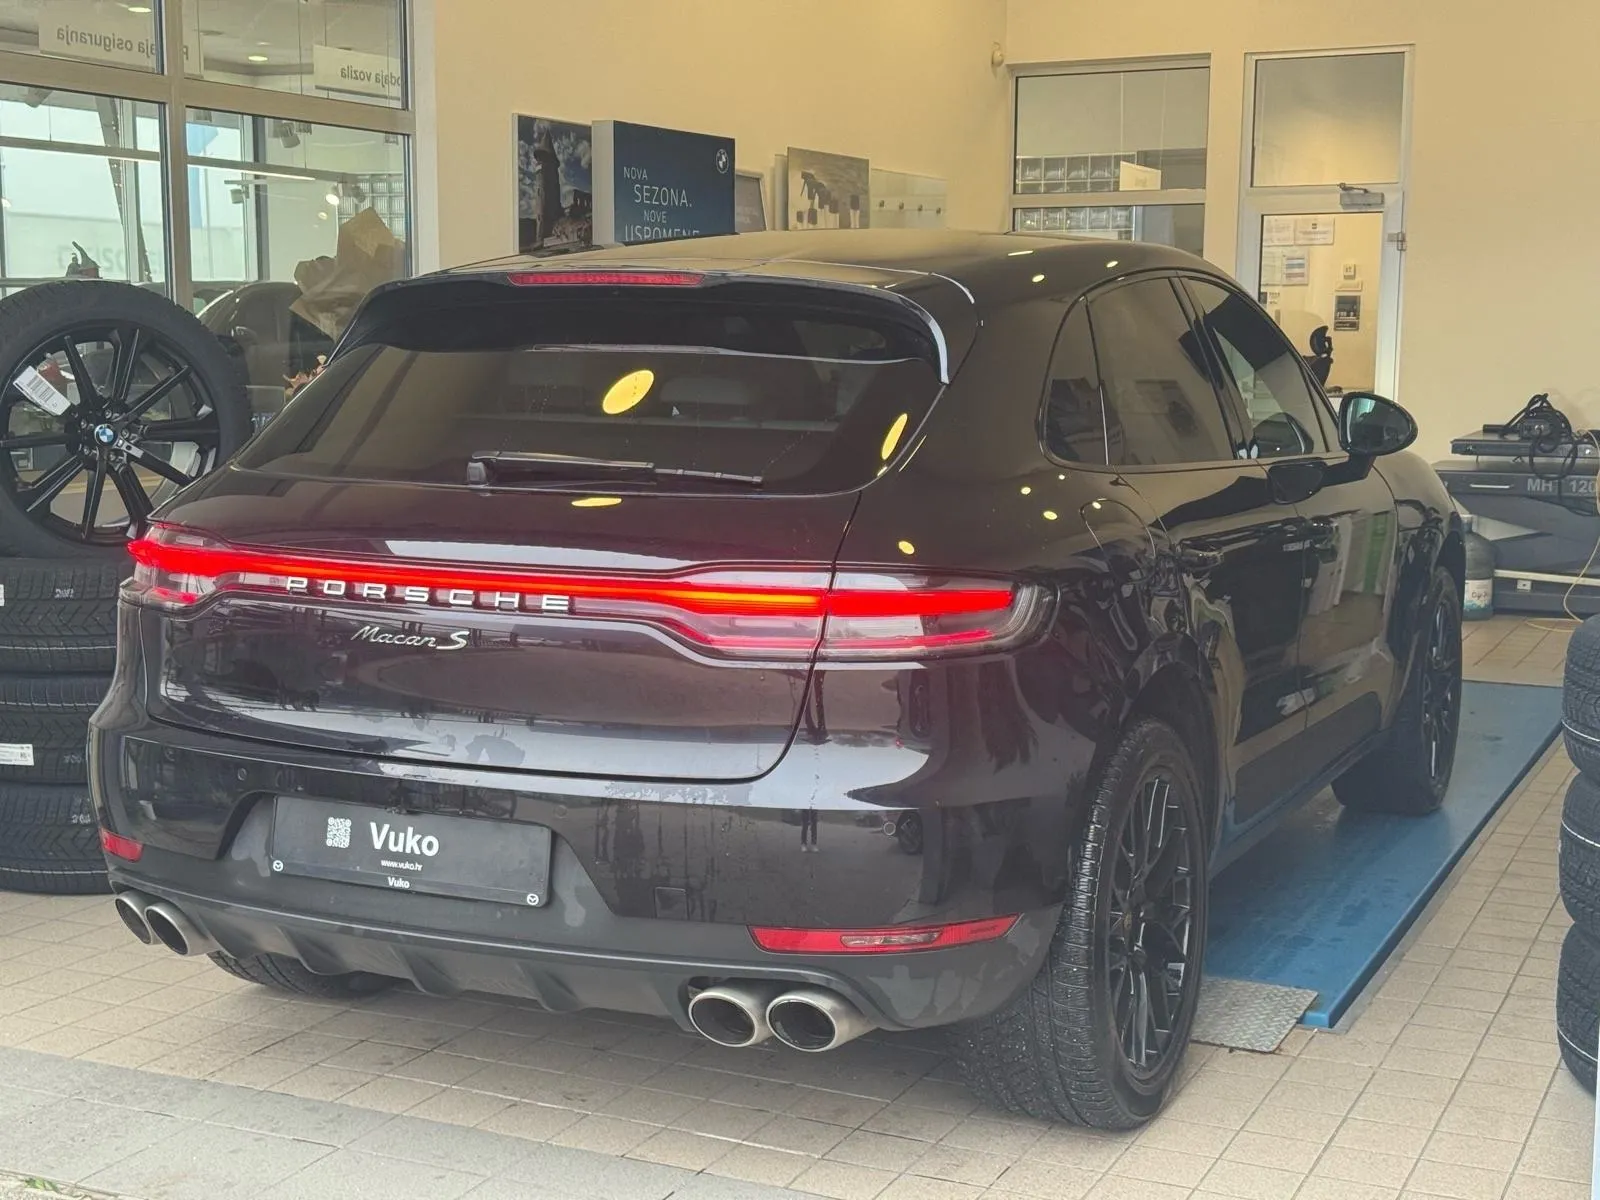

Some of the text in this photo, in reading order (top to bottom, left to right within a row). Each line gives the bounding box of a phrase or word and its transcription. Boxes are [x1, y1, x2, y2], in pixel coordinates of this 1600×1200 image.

[623, 166, 648, 181] NOVA
[633, 183, 693, 208] SEZONA.
[643, 209, 668, 224] NOVE
[286, 577, 570, 611] PORSCHE
[350, 624, 471, 650] Macan S
[369, 821, 440, 857] Vuko
[380, 859, 424, 872] www.vuko.hr
[387, 876, 411, 889] Vuko
